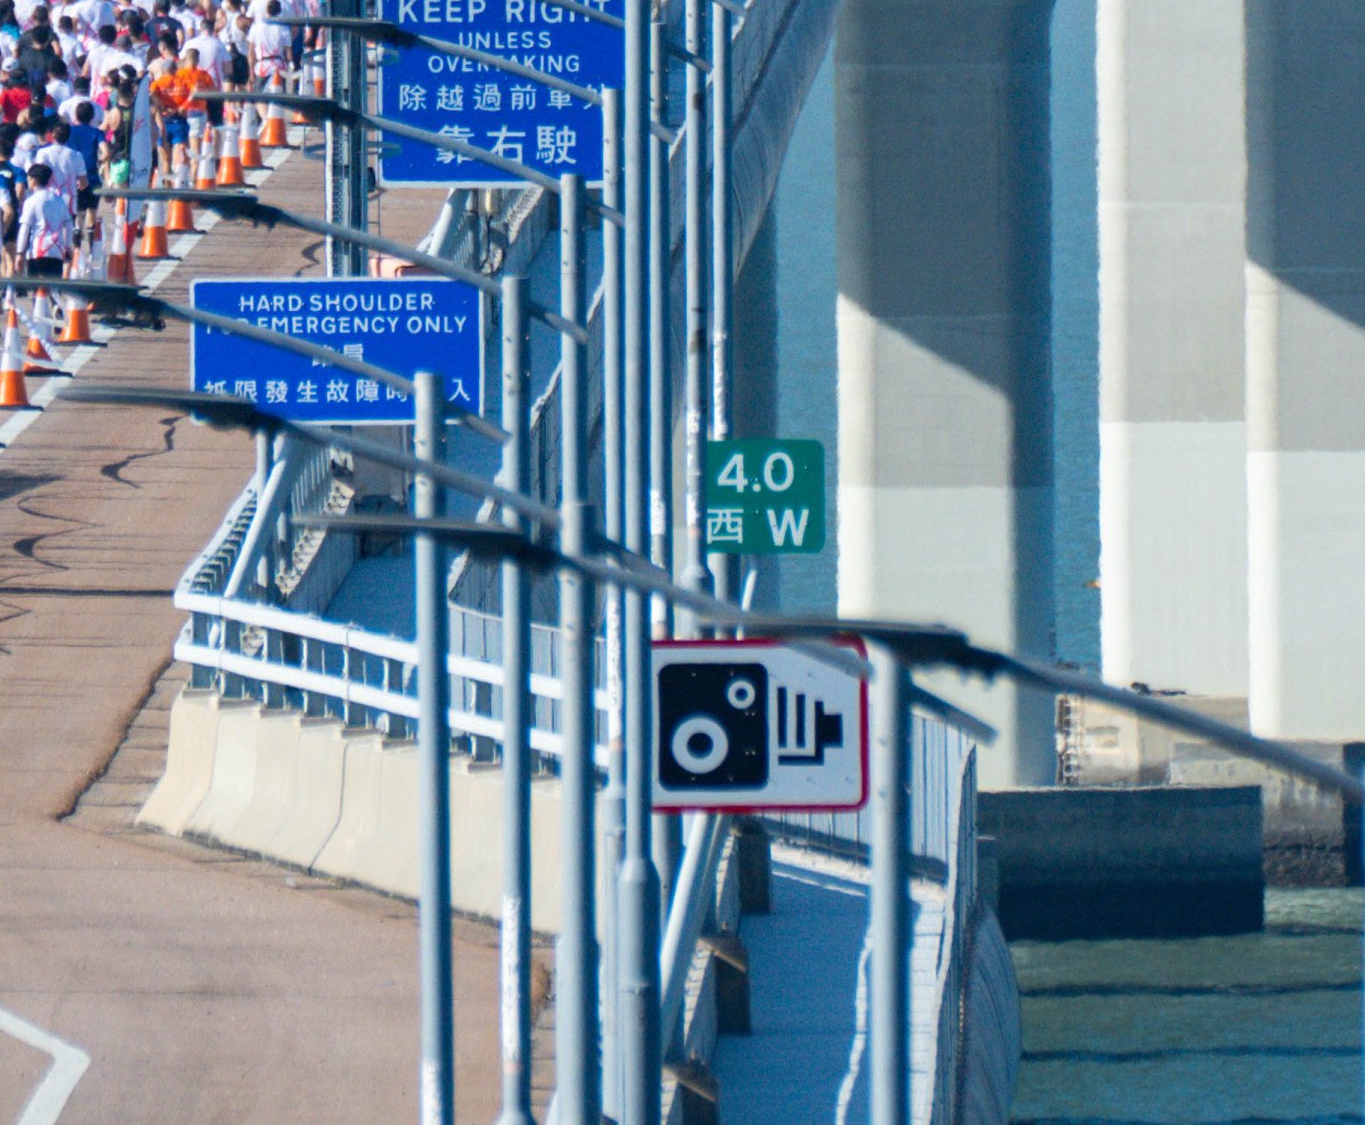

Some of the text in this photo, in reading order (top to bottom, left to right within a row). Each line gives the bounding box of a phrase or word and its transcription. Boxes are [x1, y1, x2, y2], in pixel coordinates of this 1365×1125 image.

[459, 32, 552, 49] UNLESS
[239, 294, 433, 312] HARD SHOULDER
[406, 317, 467, 334] ONLY
[716, 452, 795, 493] 4.0
[707, 508, 809, 547] 西 W
